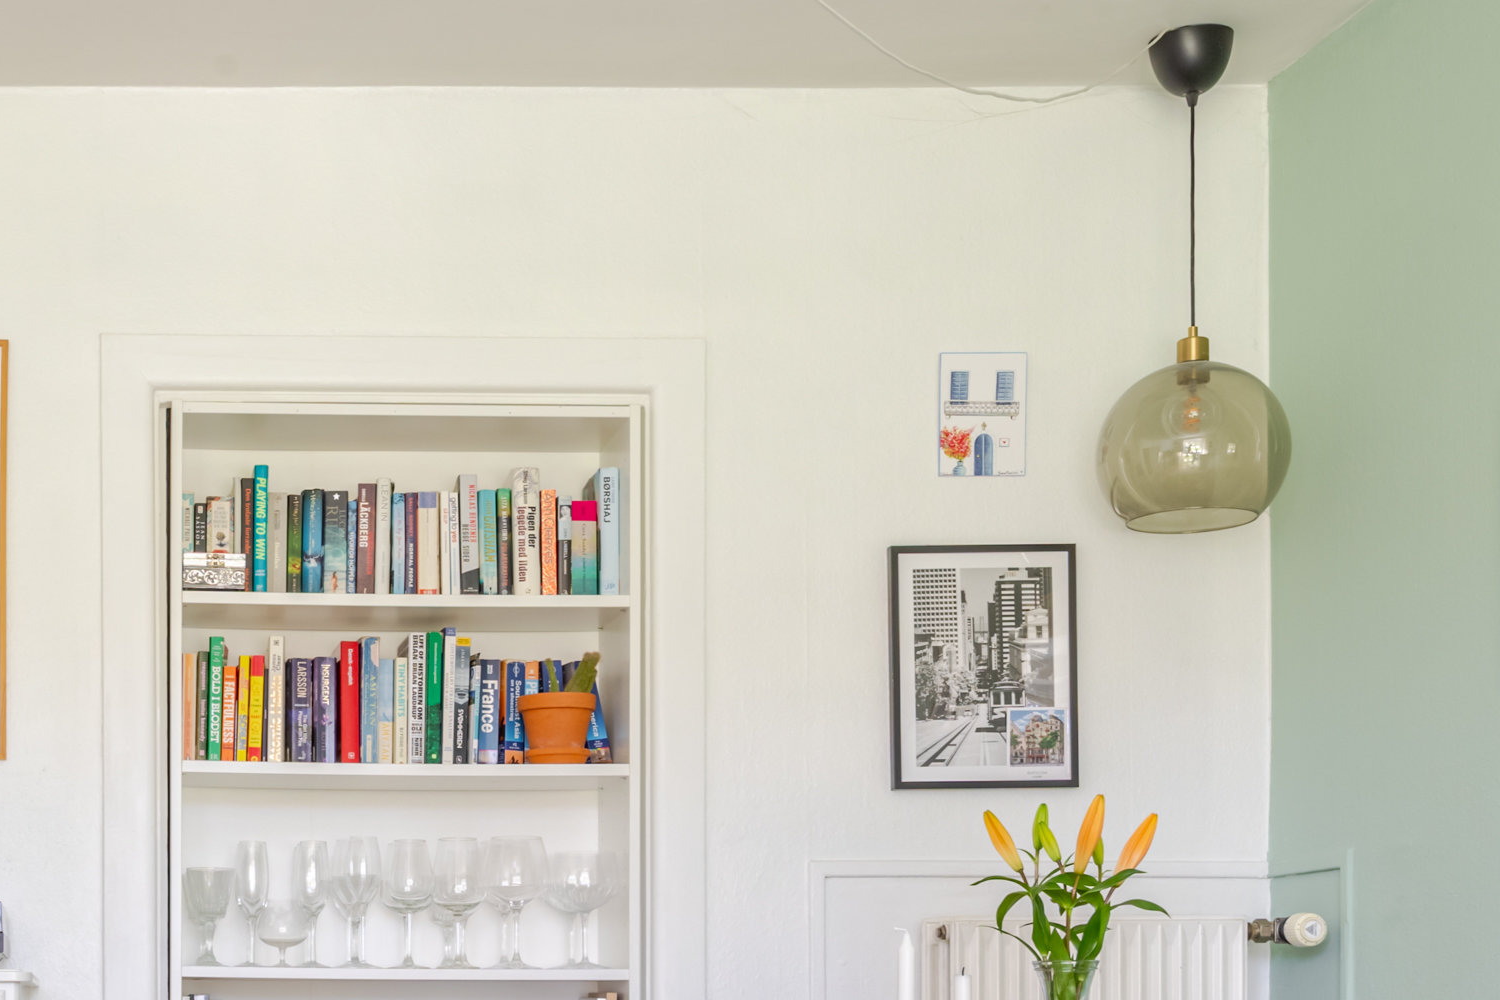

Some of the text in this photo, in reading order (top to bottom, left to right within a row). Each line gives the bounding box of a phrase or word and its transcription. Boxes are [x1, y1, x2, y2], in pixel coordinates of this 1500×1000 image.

[256, 477, 266, 560] PLAYING TO WIN
[381, 512, 388, 521] IN
[449, 497, 458, 521] getting
[603, 477, 611, 523] BØRSHAJ
[360, 502, 370, 547] LÄCKBERG
[484, 516, 496, 562] GRISHAM
[517, 507, 527, 582] legede med ilden
[527, 506, 537, 548] Pigen der
[544, 493, 554, 564] Ann Cleeves
[398, 664, 406, 684] TINY
[418, 651, 423, 659] OF
[212, 666, 221, 694] BOLD
[297, 661, 307, 698] LARSSON
[321, 664, 331, 705] INSURGENT
[211, 703, 219, 743] BLODET
[223, 681, 235, 743] FACTFULNESS
[418, 707, 423, 720] OM
[482, 680, 498, 733] France
